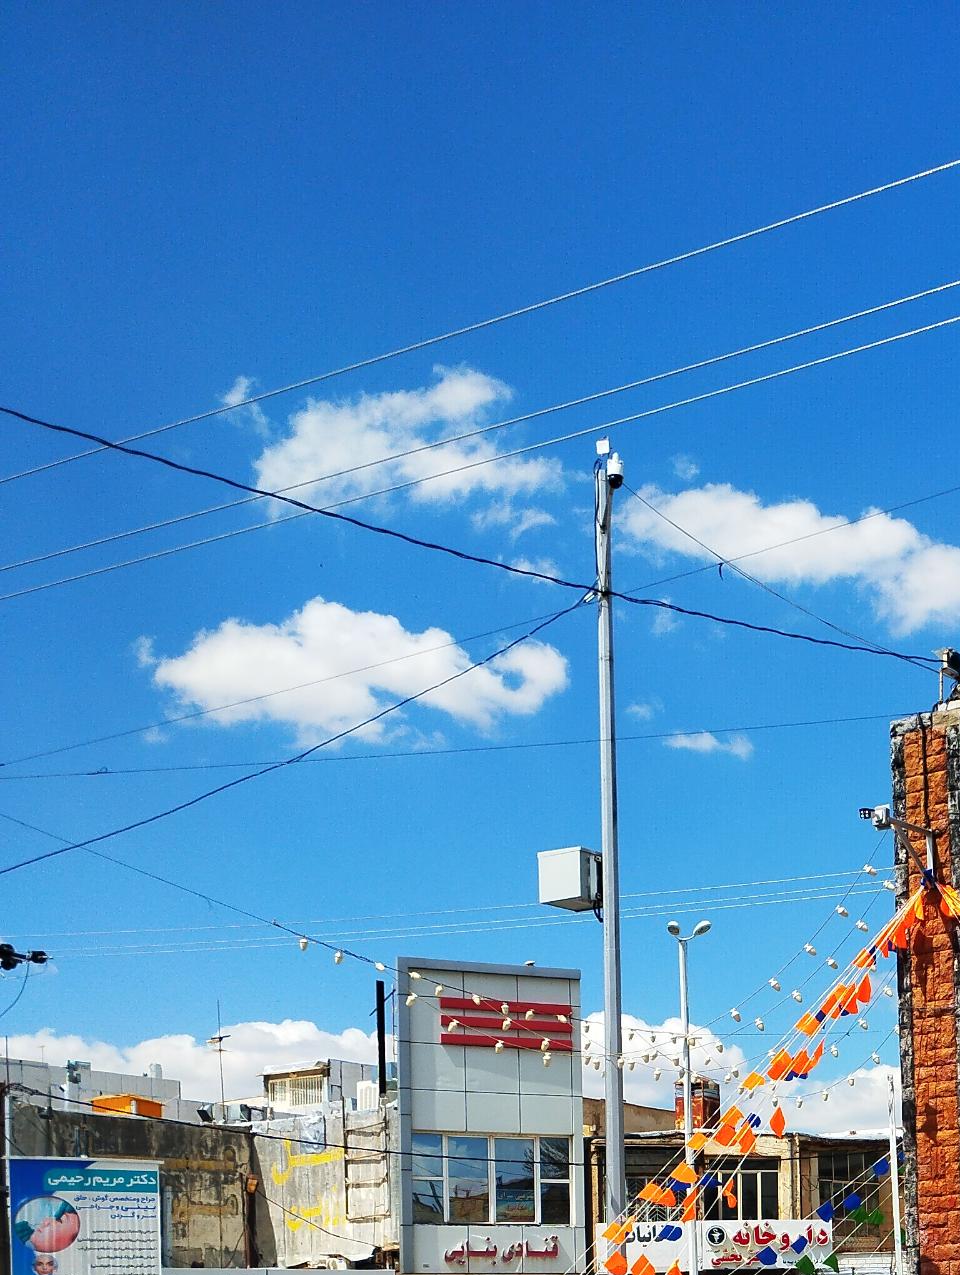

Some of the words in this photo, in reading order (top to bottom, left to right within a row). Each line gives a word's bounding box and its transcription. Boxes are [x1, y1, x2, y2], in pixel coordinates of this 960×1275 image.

[47, 1174, 91, 1187] رحیمی
[92, 1175, 124, 1187] مریم
[126, 1174, 157, 1187] دکتر
[732, 1221, 829, 1251] داوخانه
[502, 1235, 559, 1264] قنادی
